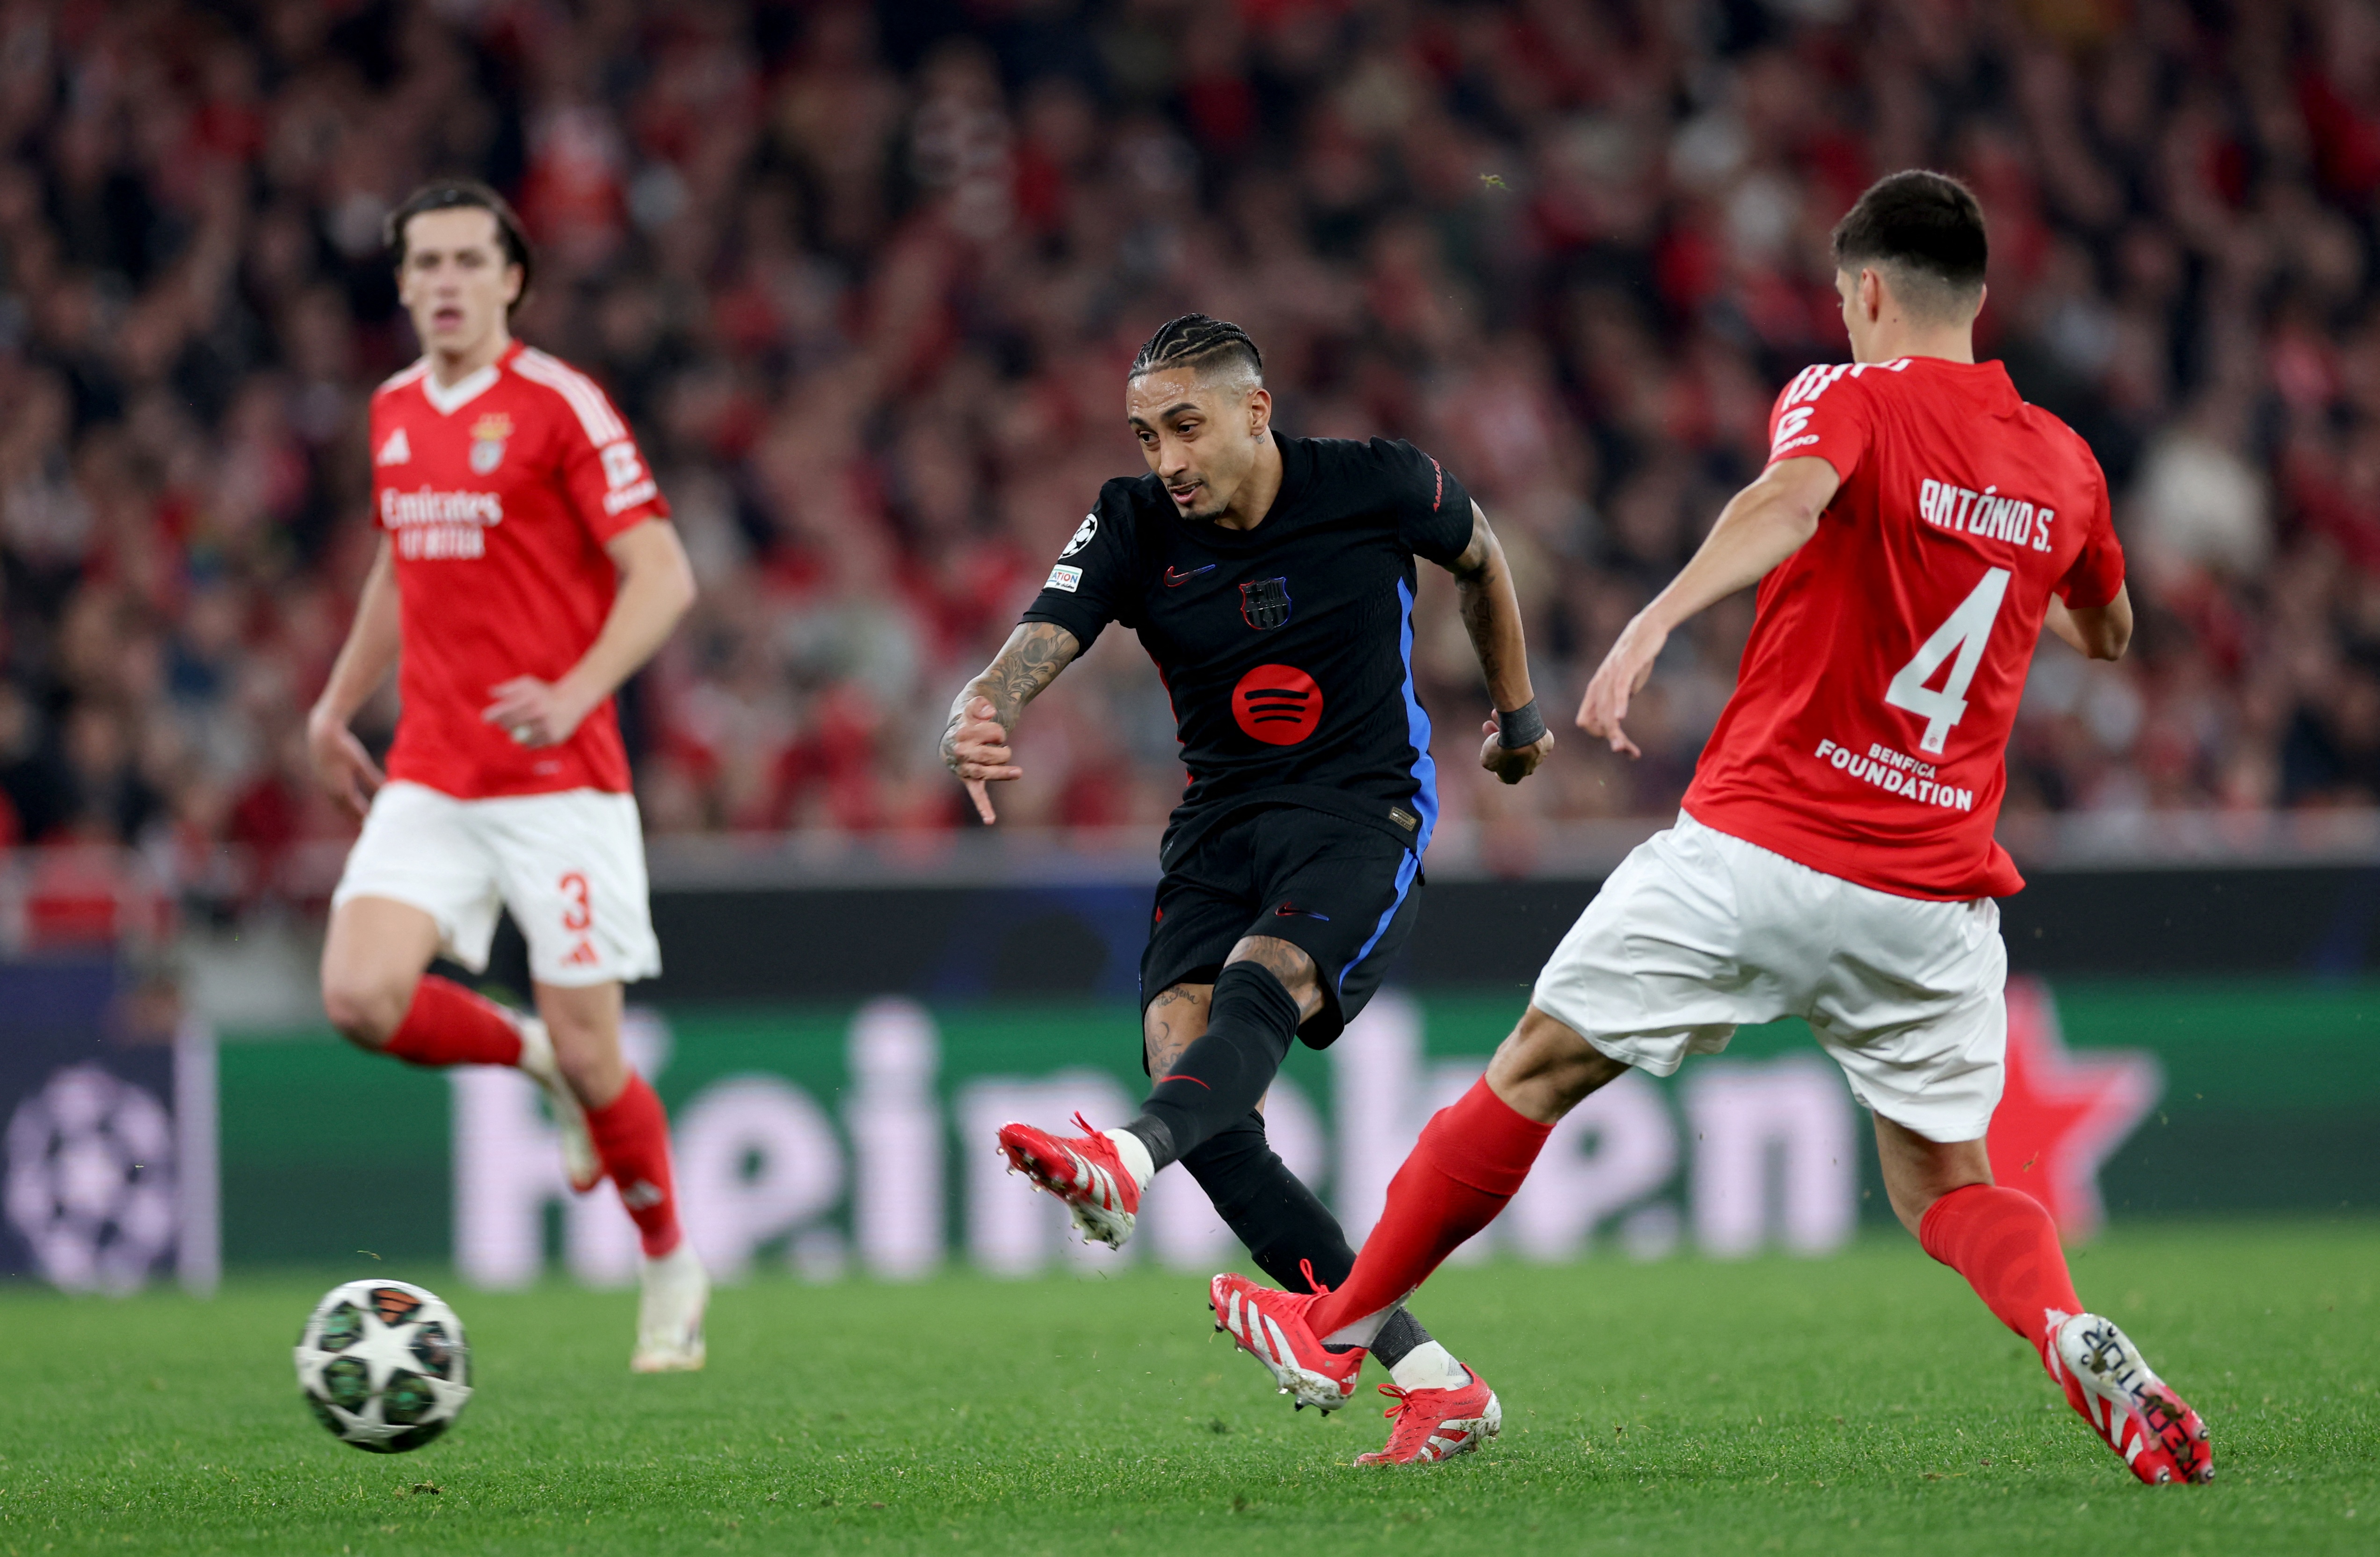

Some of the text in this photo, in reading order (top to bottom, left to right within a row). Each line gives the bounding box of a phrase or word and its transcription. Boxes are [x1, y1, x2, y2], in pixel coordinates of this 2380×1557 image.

[1919, 478, 2054, 553] ANTÓNIO S.
[1885, 566, 2012, 754] 4
[1814, 738, 1973, 812] FOUNDATION
[1868, 742, 1936, 779] BENFICA
[559, 871, 591, 931] 3
